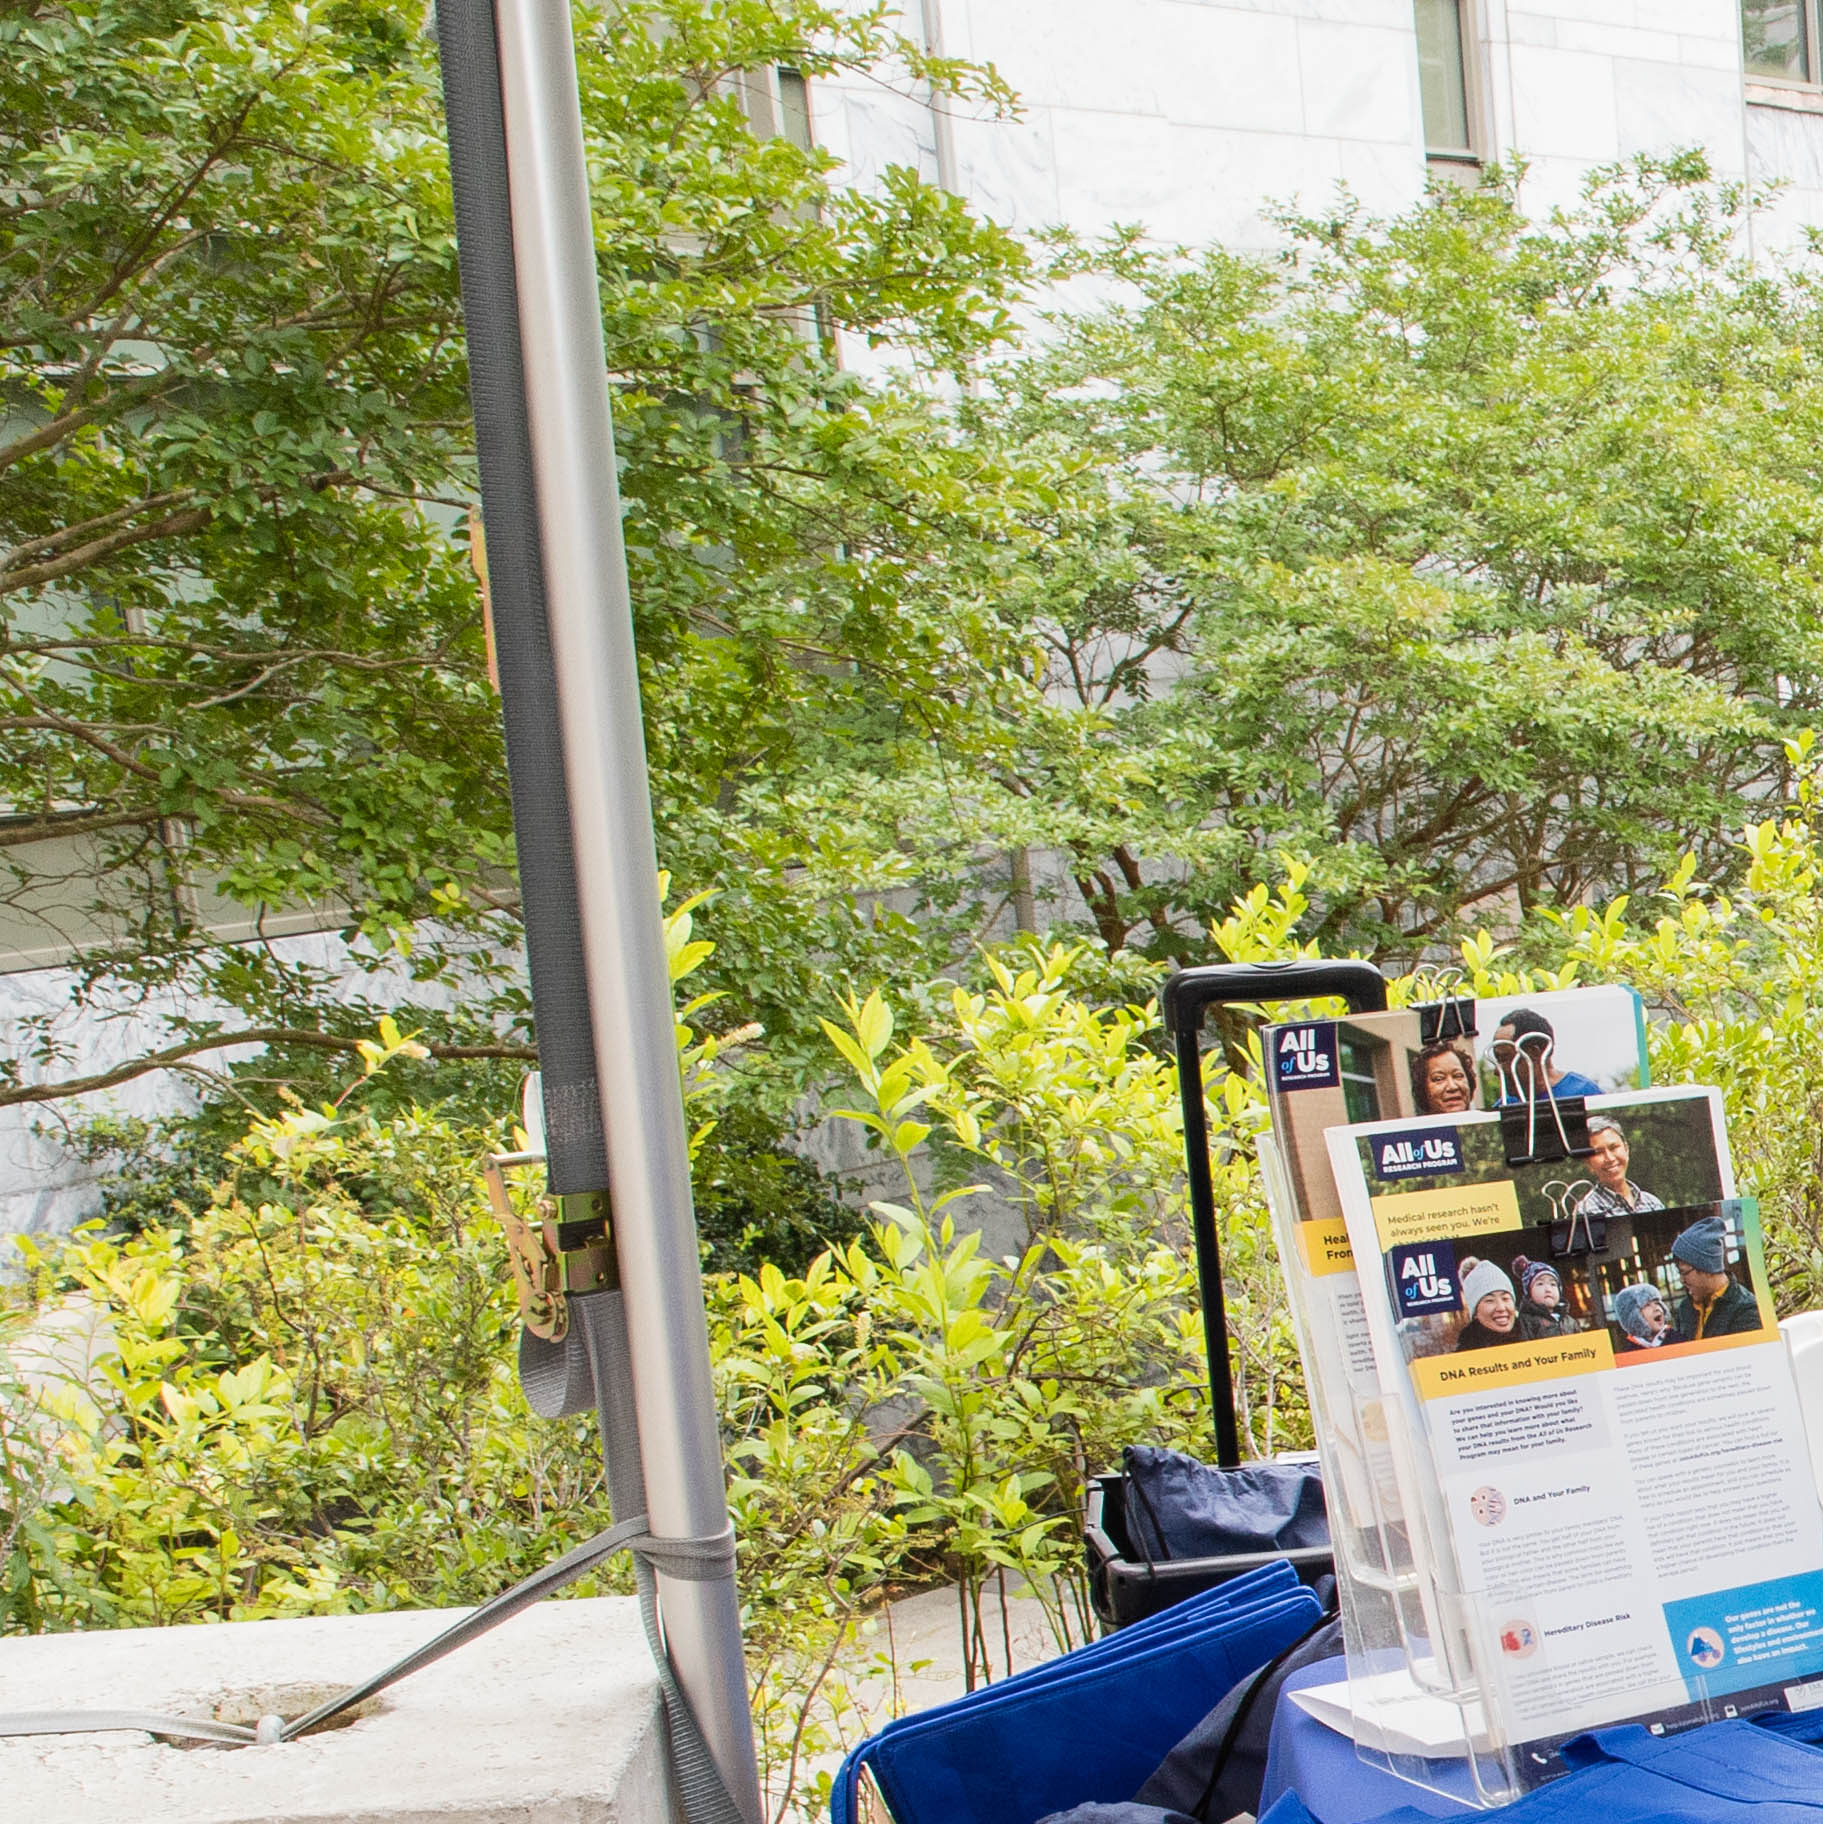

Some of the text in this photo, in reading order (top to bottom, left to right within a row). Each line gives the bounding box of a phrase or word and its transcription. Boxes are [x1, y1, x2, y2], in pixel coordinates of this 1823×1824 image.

[1280, 1028, 1316, 1053] All
[1281, 1051, 1329, 1074] of Us
[1381, 1138, 1455, 1166] All of Us
[1383, 1158, 1458, 1173] RESEARCH PROGRAM
[1388, 1203, 1500, 1225] Medical research hasn't
[1390, 1215, 1500, 1238] always seen you. We're
[1401, 1253, 1435, 1280] All
[1405, 1275, 1452, 1300] of Us
[1406, 1296, 1454, 1307] RESEARCH PROGRAM
[1440, 1348, 1597, 1382] DNA Results and Your Family
[1513, 1485, 1591, 1505] DNA and Your Family
[1544, 1612, 1631, 1637] Hereditary Disease Risk
